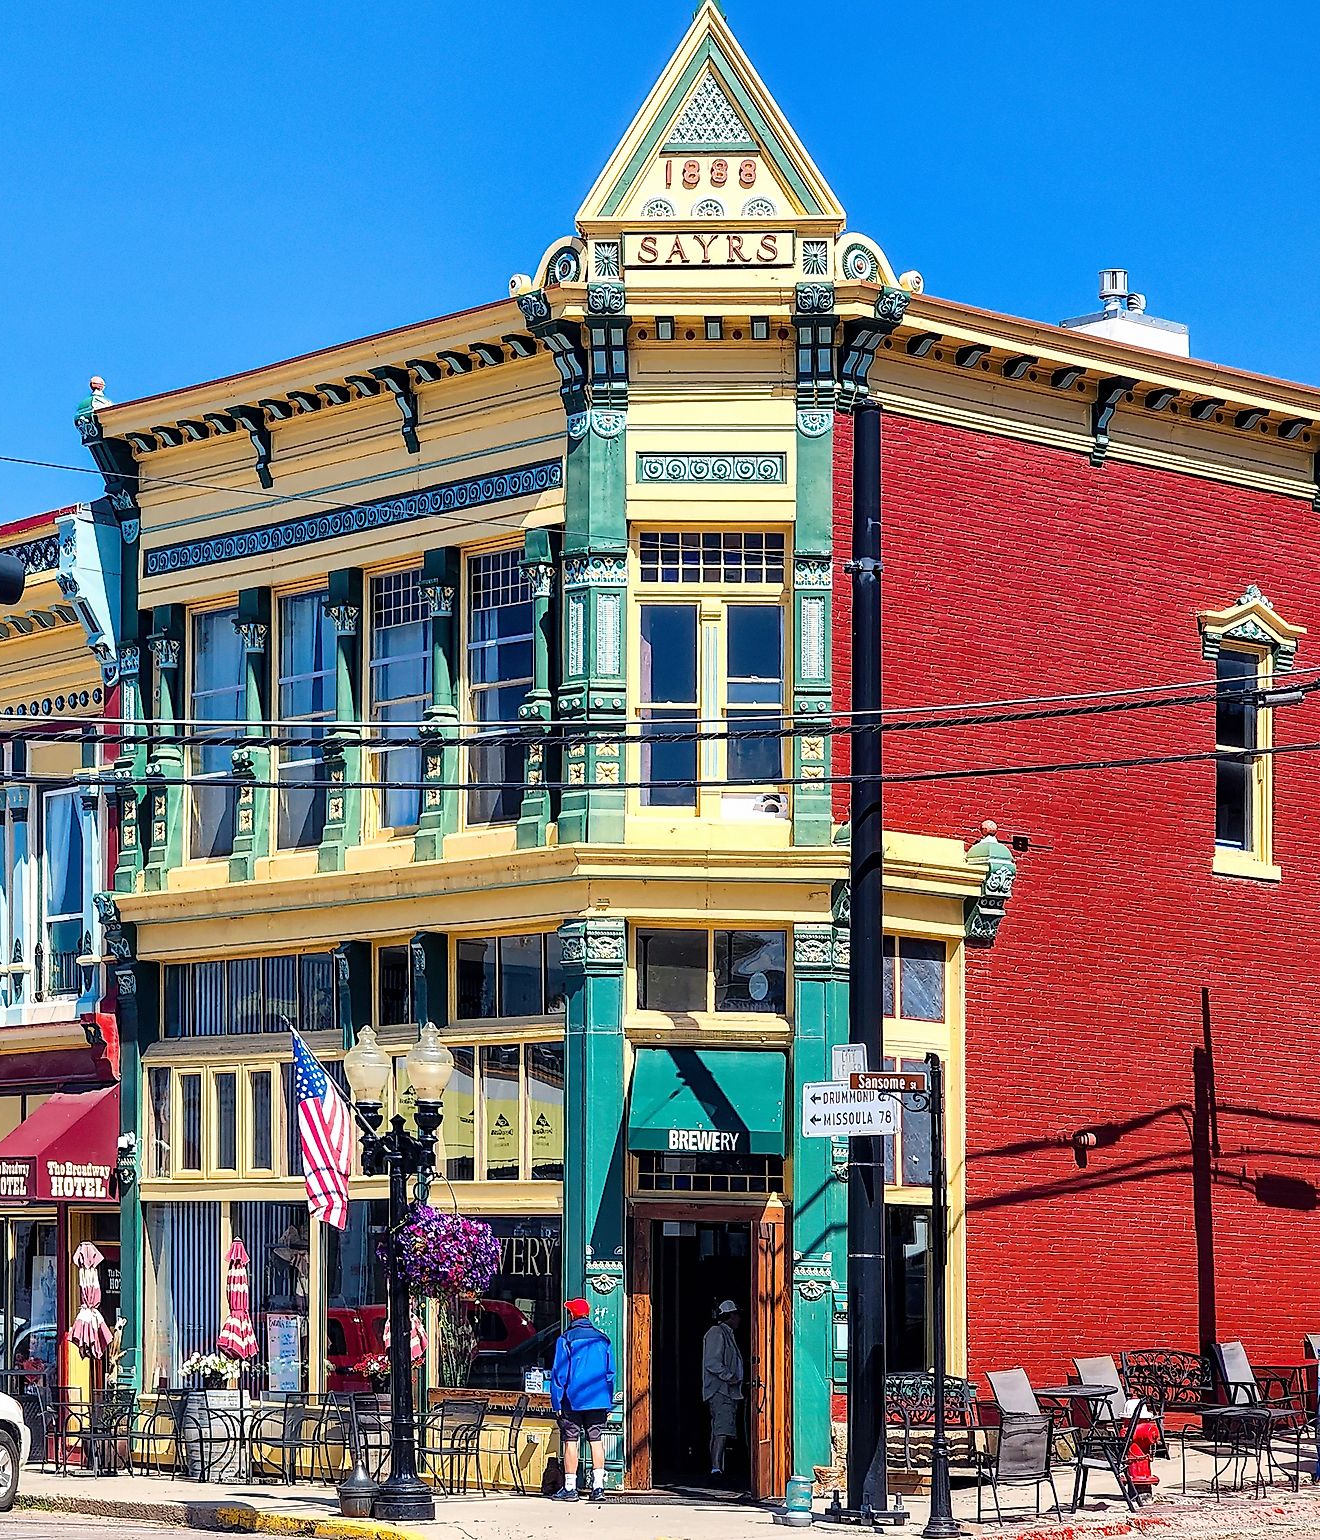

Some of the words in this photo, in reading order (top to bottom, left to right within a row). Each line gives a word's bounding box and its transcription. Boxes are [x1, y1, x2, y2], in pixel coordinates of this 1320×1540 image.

[666, 159, 757, 189] 1888
[637, 234, 778, 264] SAYRS
[858, 1074, 906, 1090] Sansome
[823, 1090, 875, 1105] DRUMMOND
[823, 1111, 873, 1126] MISSOULA
[878, 1110, 892, 1124] 78
[668, 1129, 740, 1151] BREWERY
[1, 1161, 30, 1178] Broadway
[47, 1161, 64, 1176] The
[65, 1161, 111, 1180] Broadway
[50, 1176, 106, 1198] HOTEL
